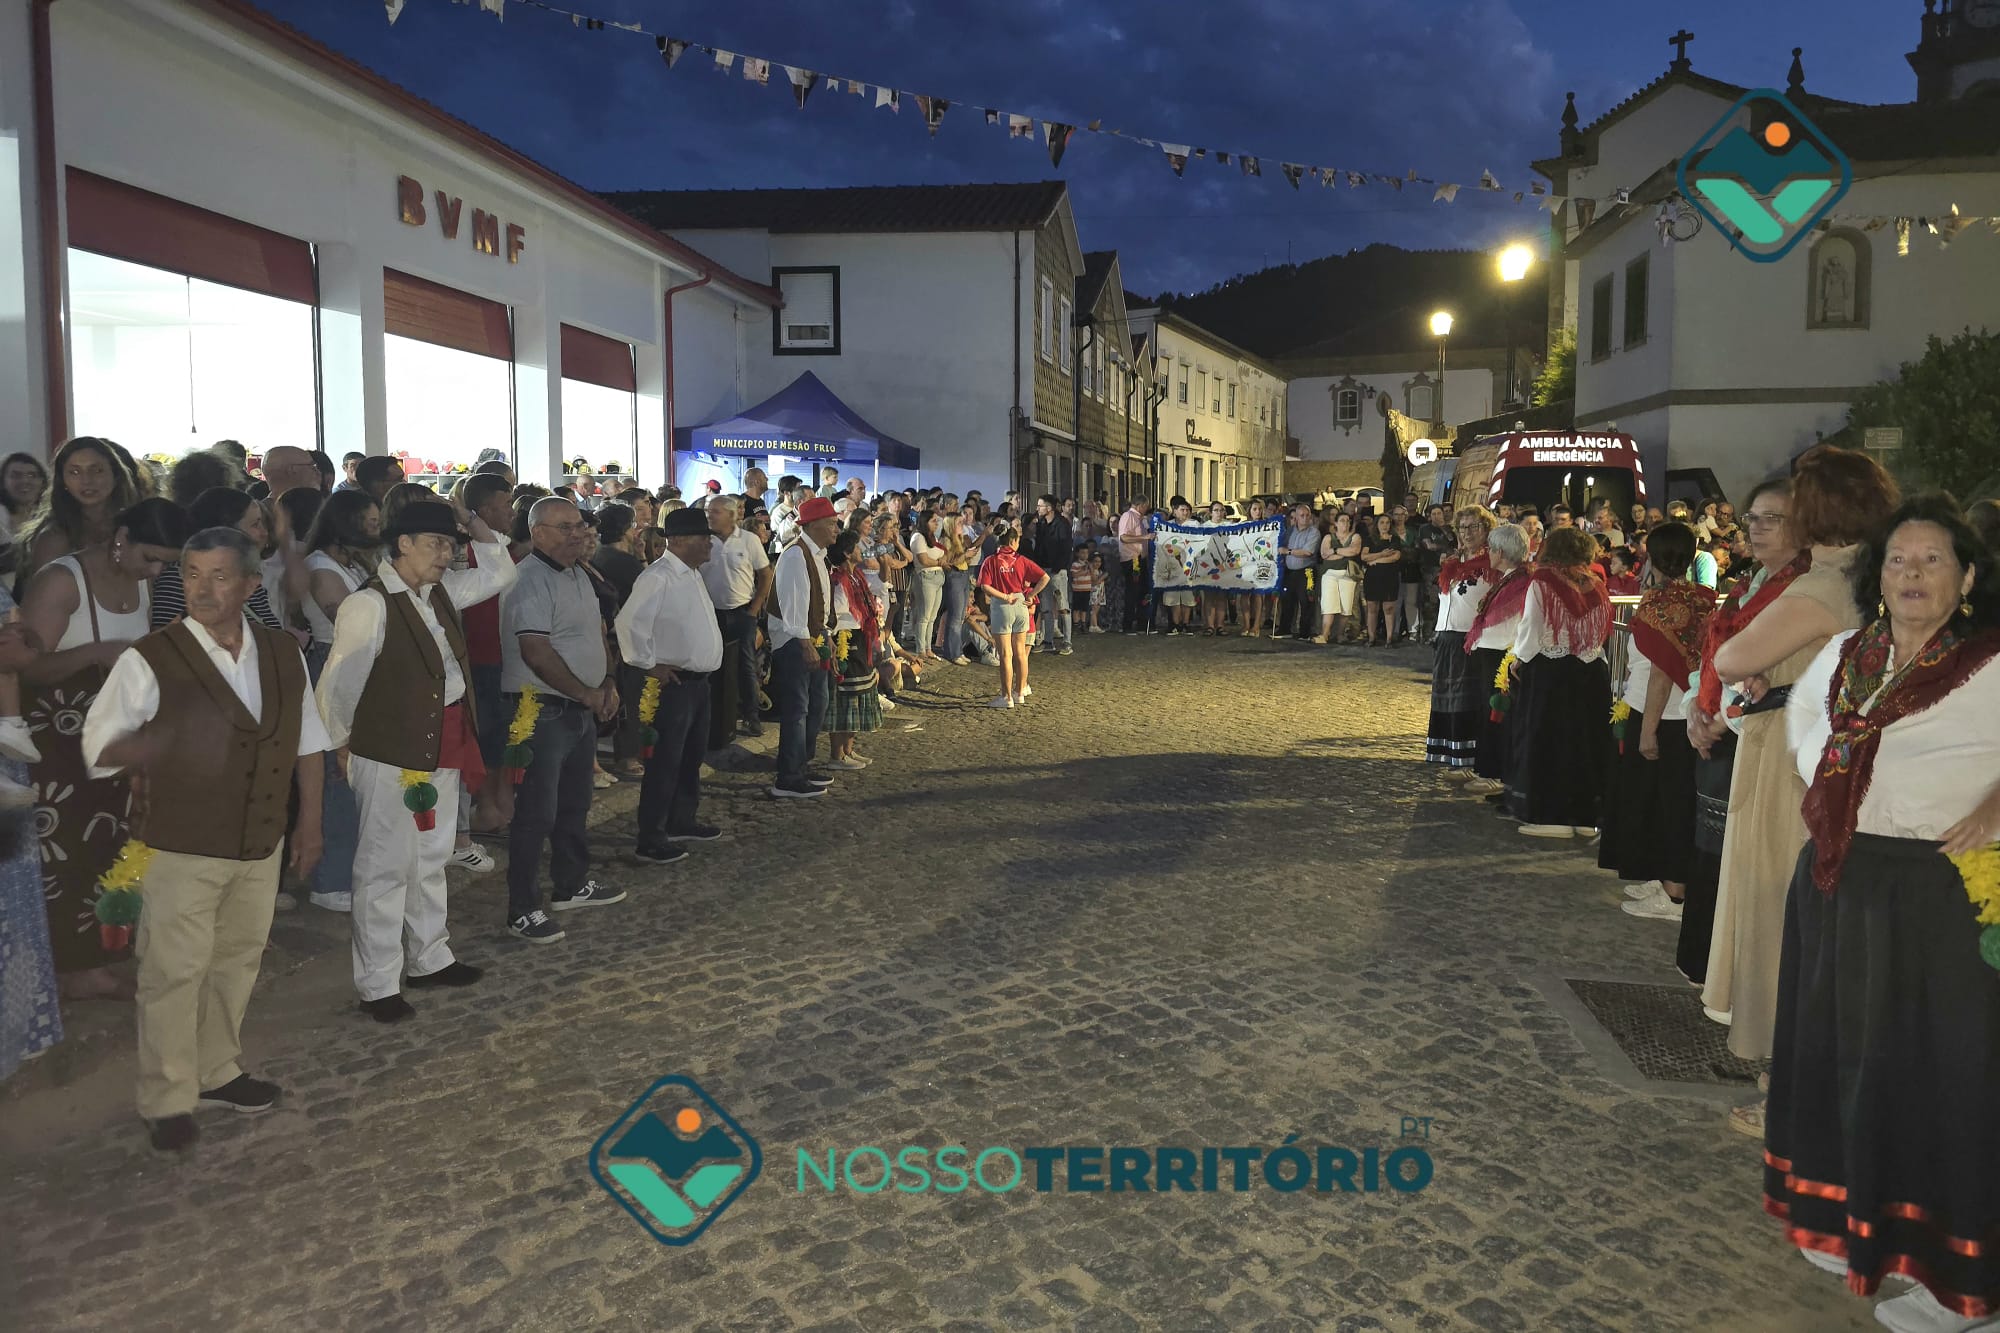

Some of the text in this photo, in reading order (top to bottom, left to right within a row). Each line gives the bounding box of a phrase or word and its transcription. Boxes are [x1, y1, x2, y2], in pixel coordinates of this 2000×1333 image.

[399, 174, 526, 264] BVMF
[713, 438, 837, 453] MUNICIPIO DE MESÃO FRIO
[1519, 435, 1623, 449] AMBULÂNCIA
[1533, 449, 1604, 463] EMERGÊNCIA
